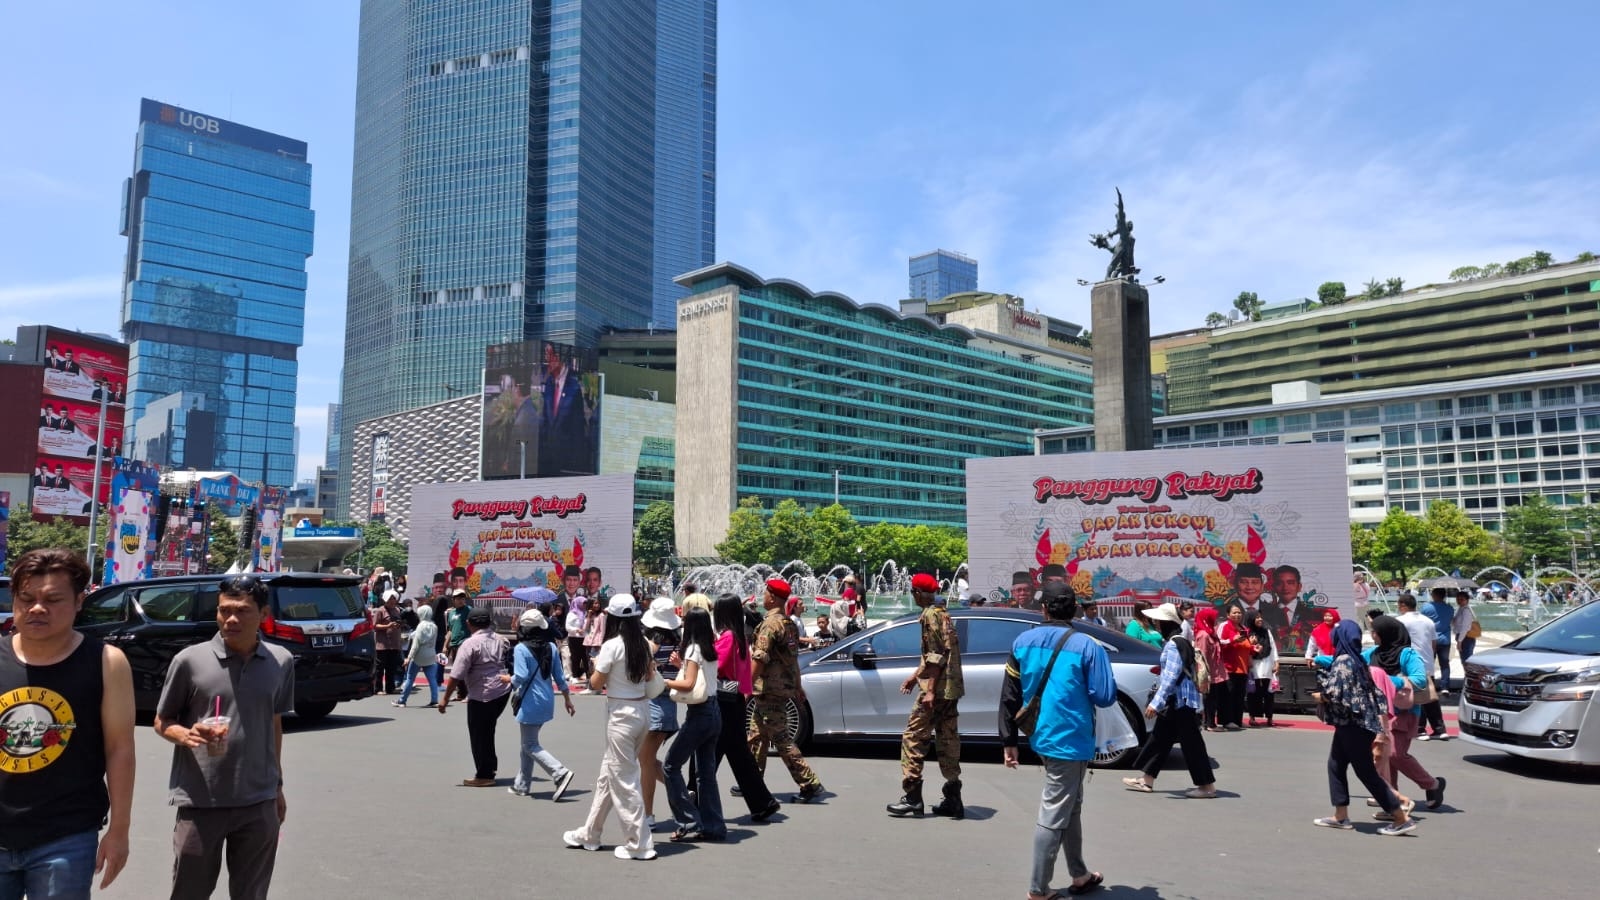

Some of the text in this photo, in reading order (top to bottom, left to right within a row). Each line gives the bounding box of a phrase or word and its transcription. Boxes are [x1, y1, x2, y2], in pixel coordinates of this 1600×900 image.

[179, 111, 220, 134] UOB
[1033, 467, 1264, 505] Panggung Rakyat
[452, 493, 586, 519] Panggung Rakyat
[1081, 514, 1142, 533] BAPAK
[1077, 542, 1224, 561] BAPAK PRABOWO
